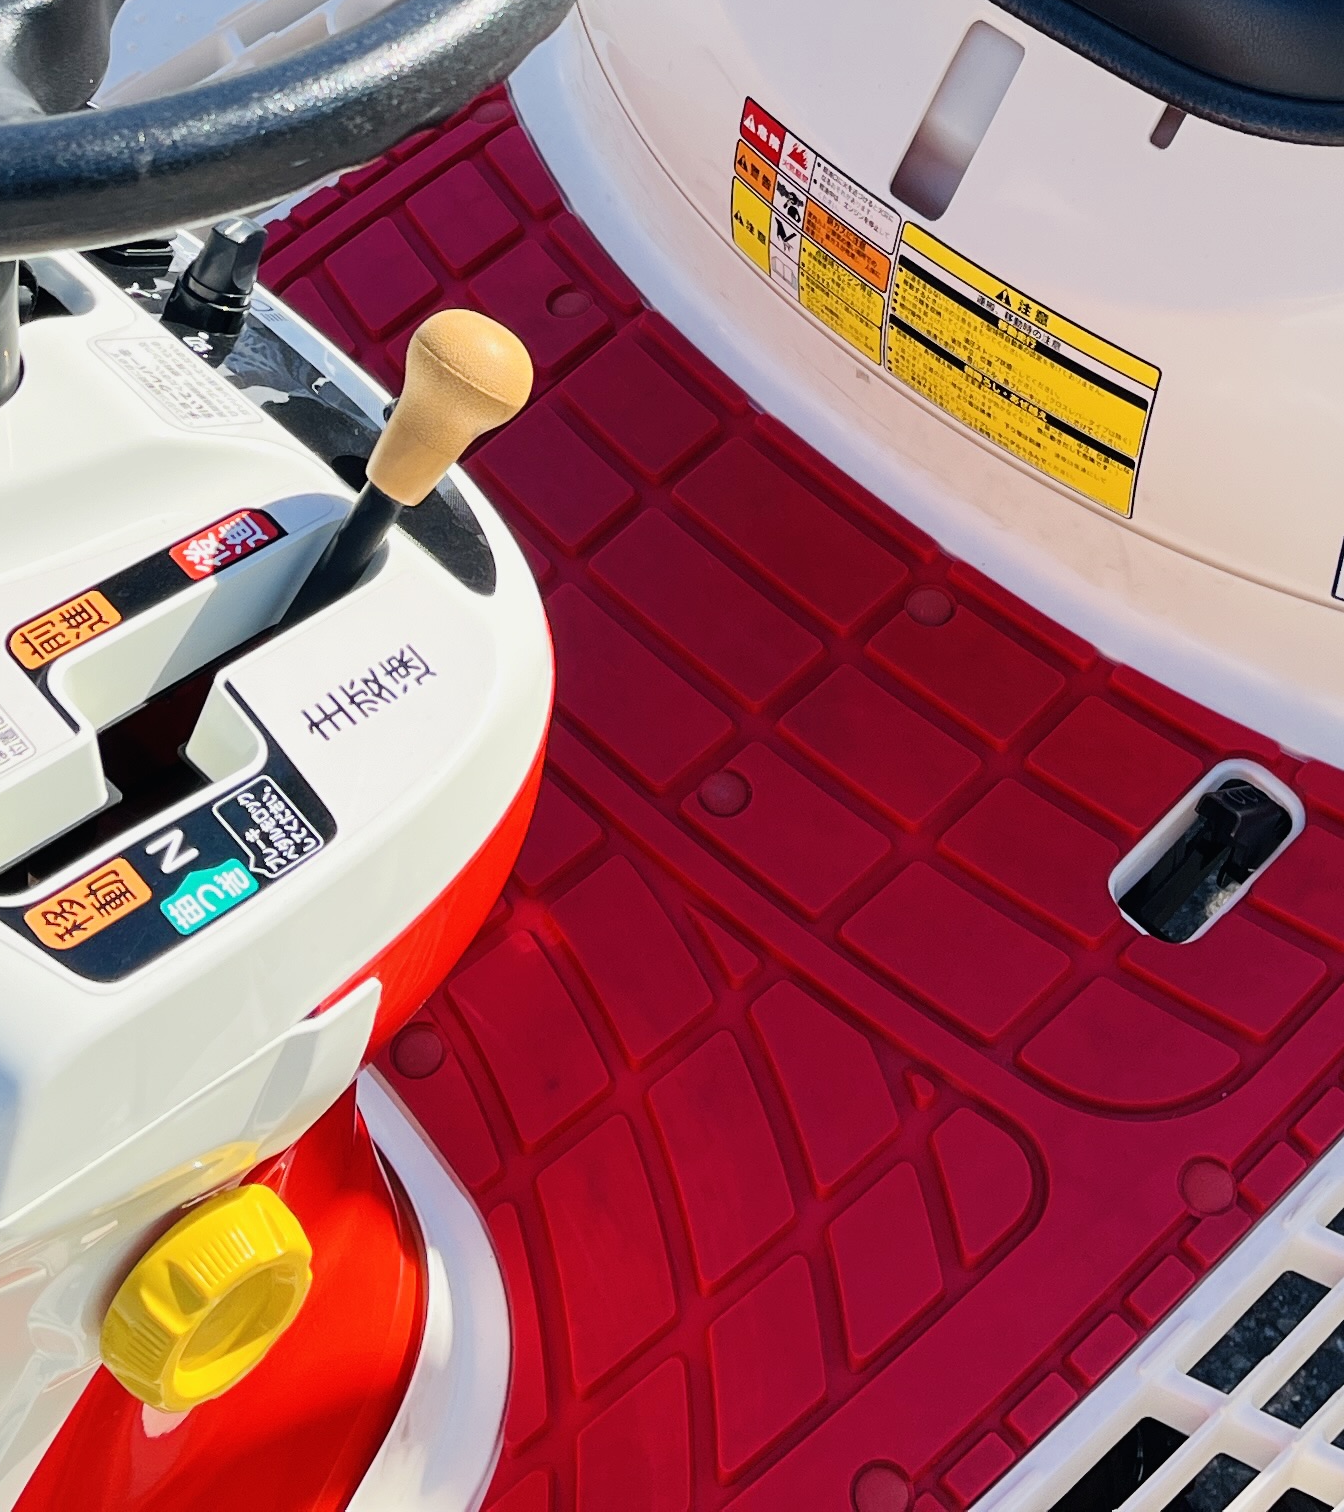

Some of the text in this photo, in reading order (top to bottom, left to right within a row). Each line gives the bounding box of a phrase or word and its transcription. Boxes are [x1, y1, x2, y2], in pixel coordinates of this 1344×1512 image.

[183, 513, 268, 573] 後進
[20, 598, 110, 661] 前進
[145, 828, 200, 874] N
[41, 868, 137, 943] 移動
